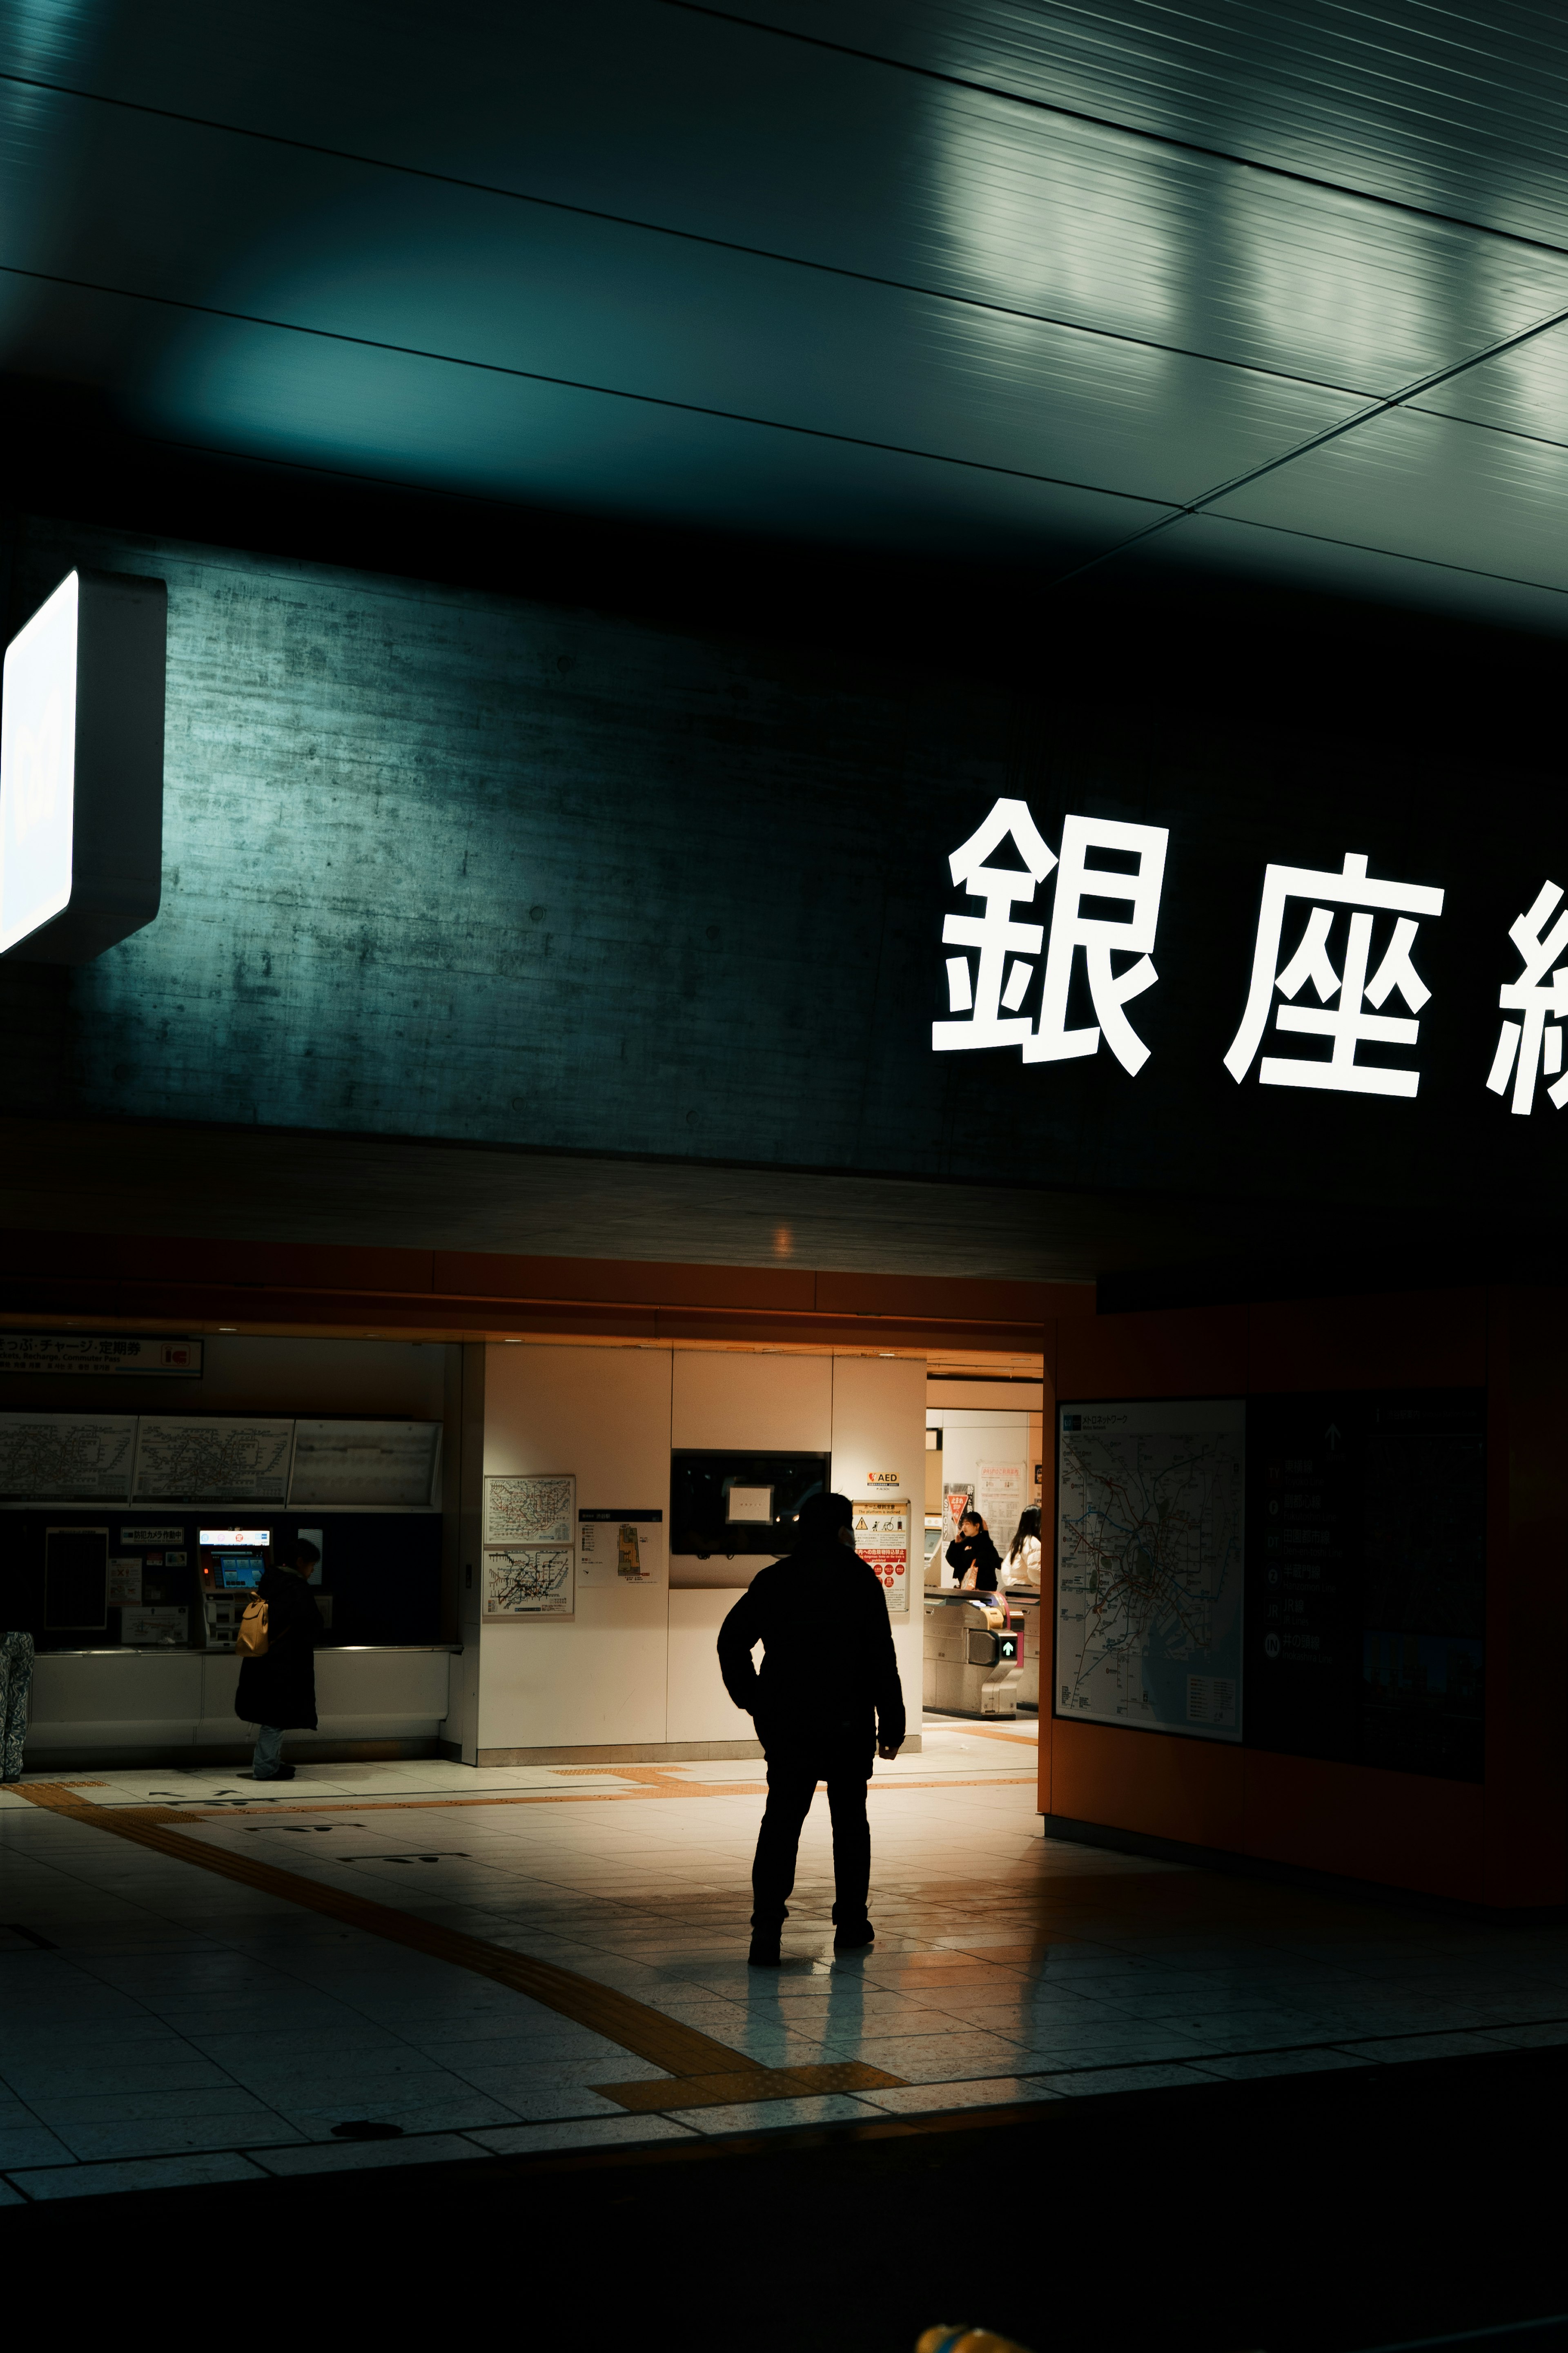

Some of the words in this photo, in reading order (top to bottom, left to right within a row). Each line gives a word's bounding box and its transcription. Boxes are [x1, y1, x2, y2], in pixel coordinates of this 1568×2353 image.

[24, 1353, 60, 1361] Recharge,
[1082, 1415, 1127, 1425] メトロネットワーク
[1267, 1639, 1278, 1651] IN
